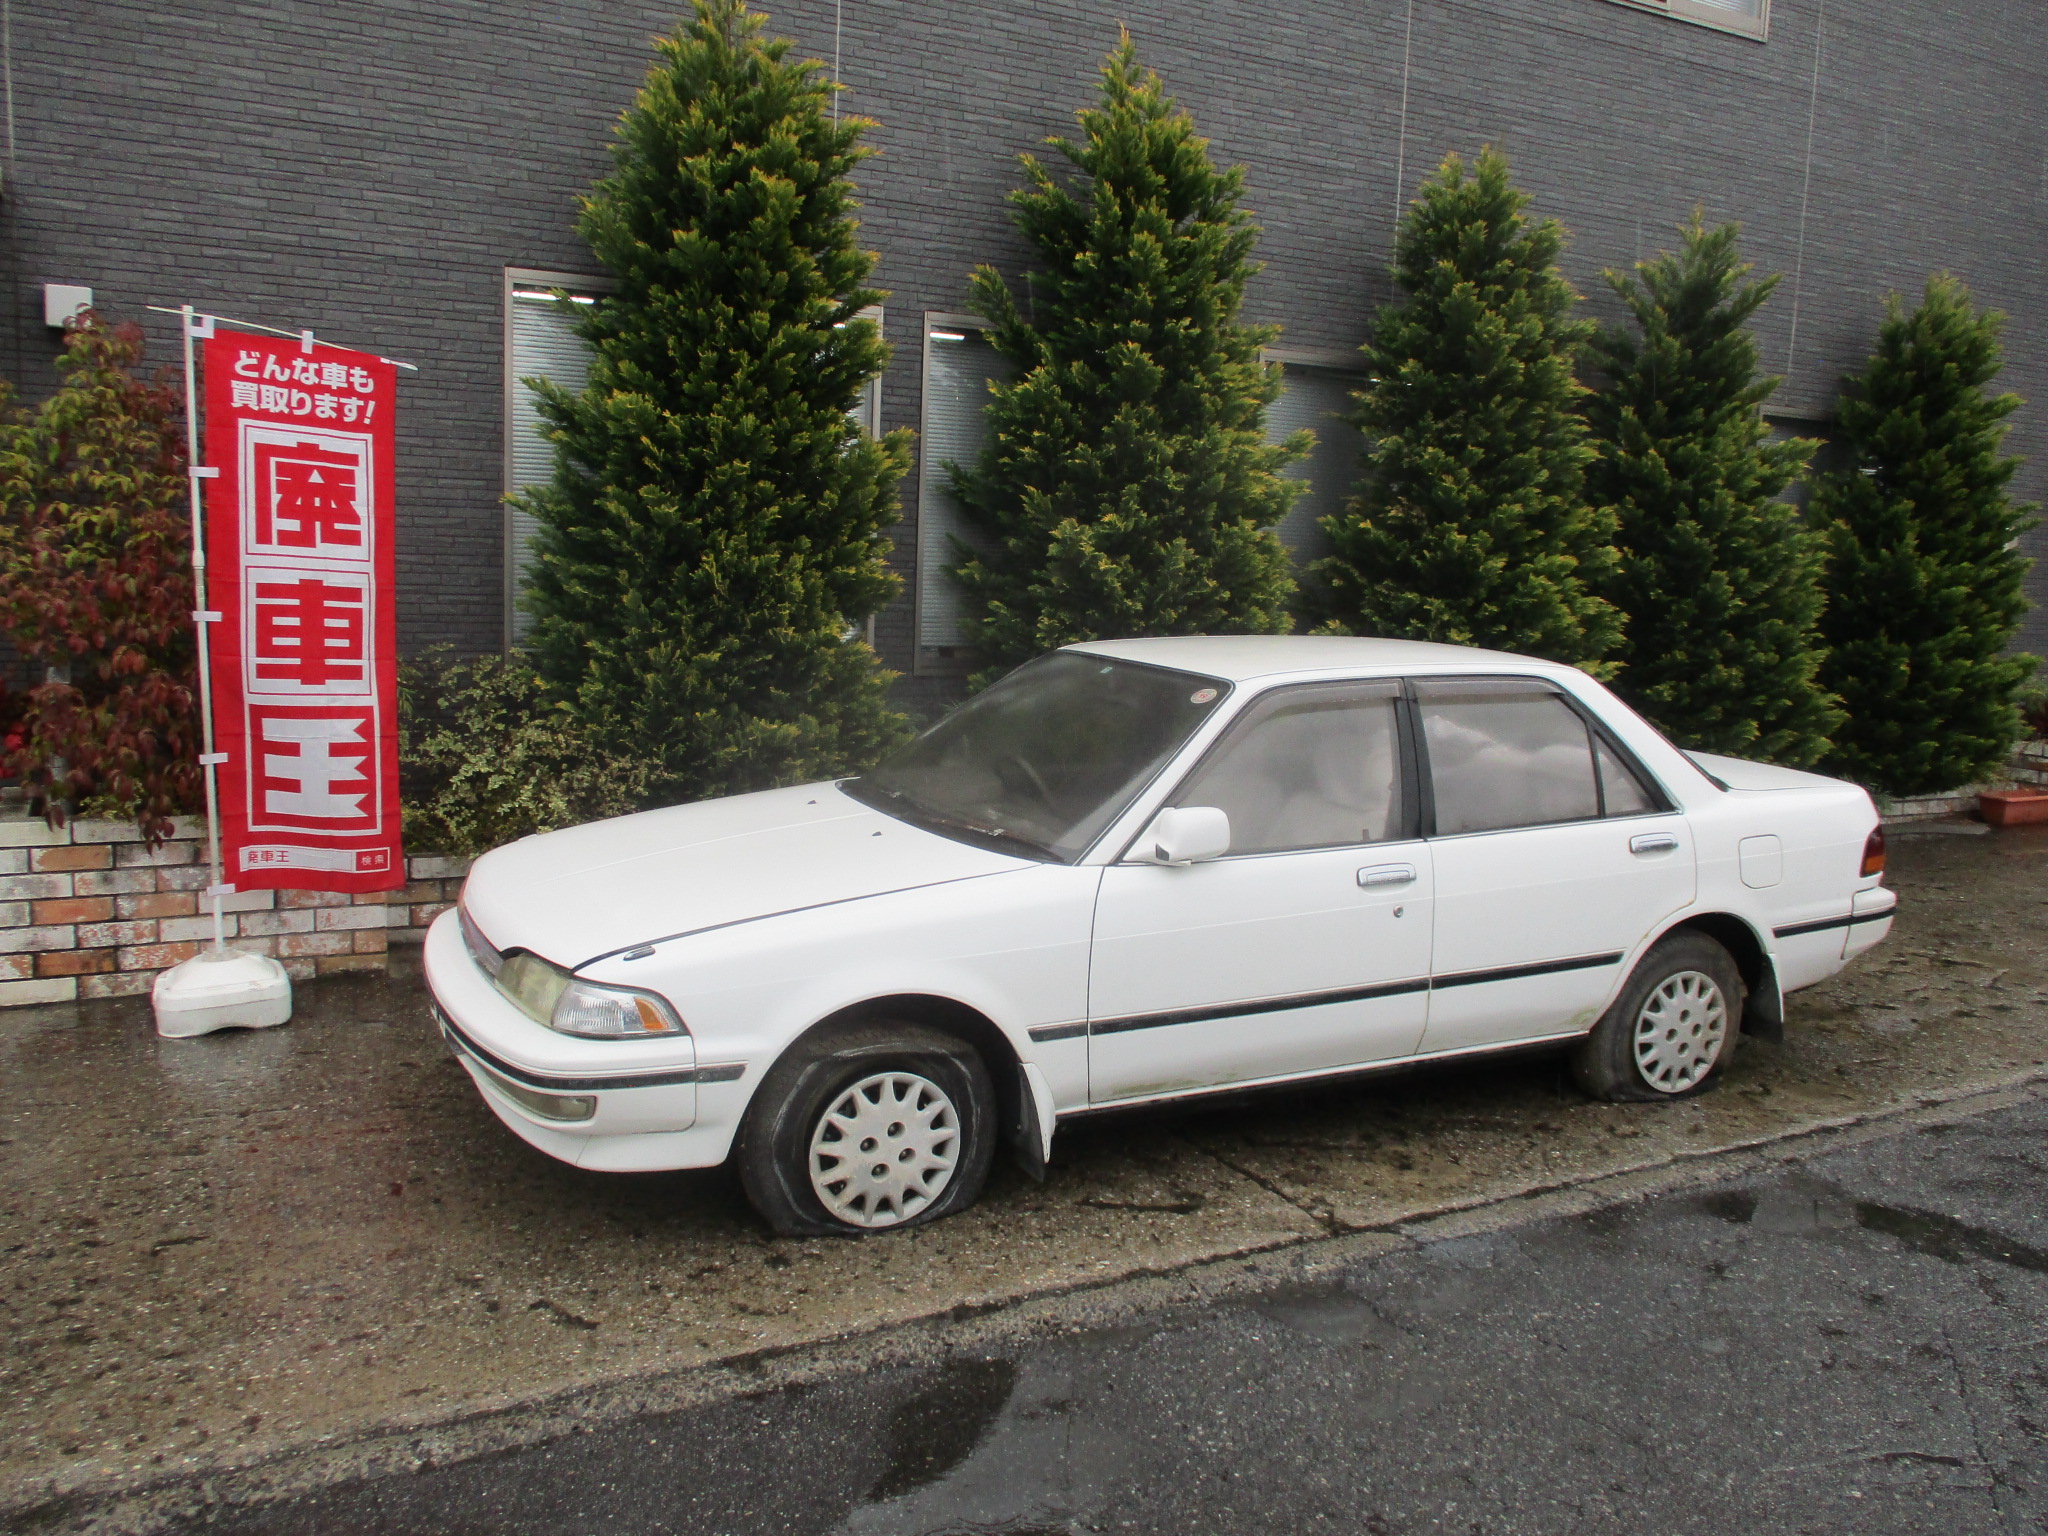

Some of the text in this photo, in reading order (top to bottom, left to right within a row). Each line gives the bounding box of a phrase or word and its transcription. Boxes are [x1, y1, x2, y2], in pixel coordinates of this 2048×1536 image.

[234, 351, 374, 393] どんな車も
[230, 380, 375, 424] 買取ります!
[253, 441, 369, 817] 廃車王
[248, 851, 289, 863] 廃車王
